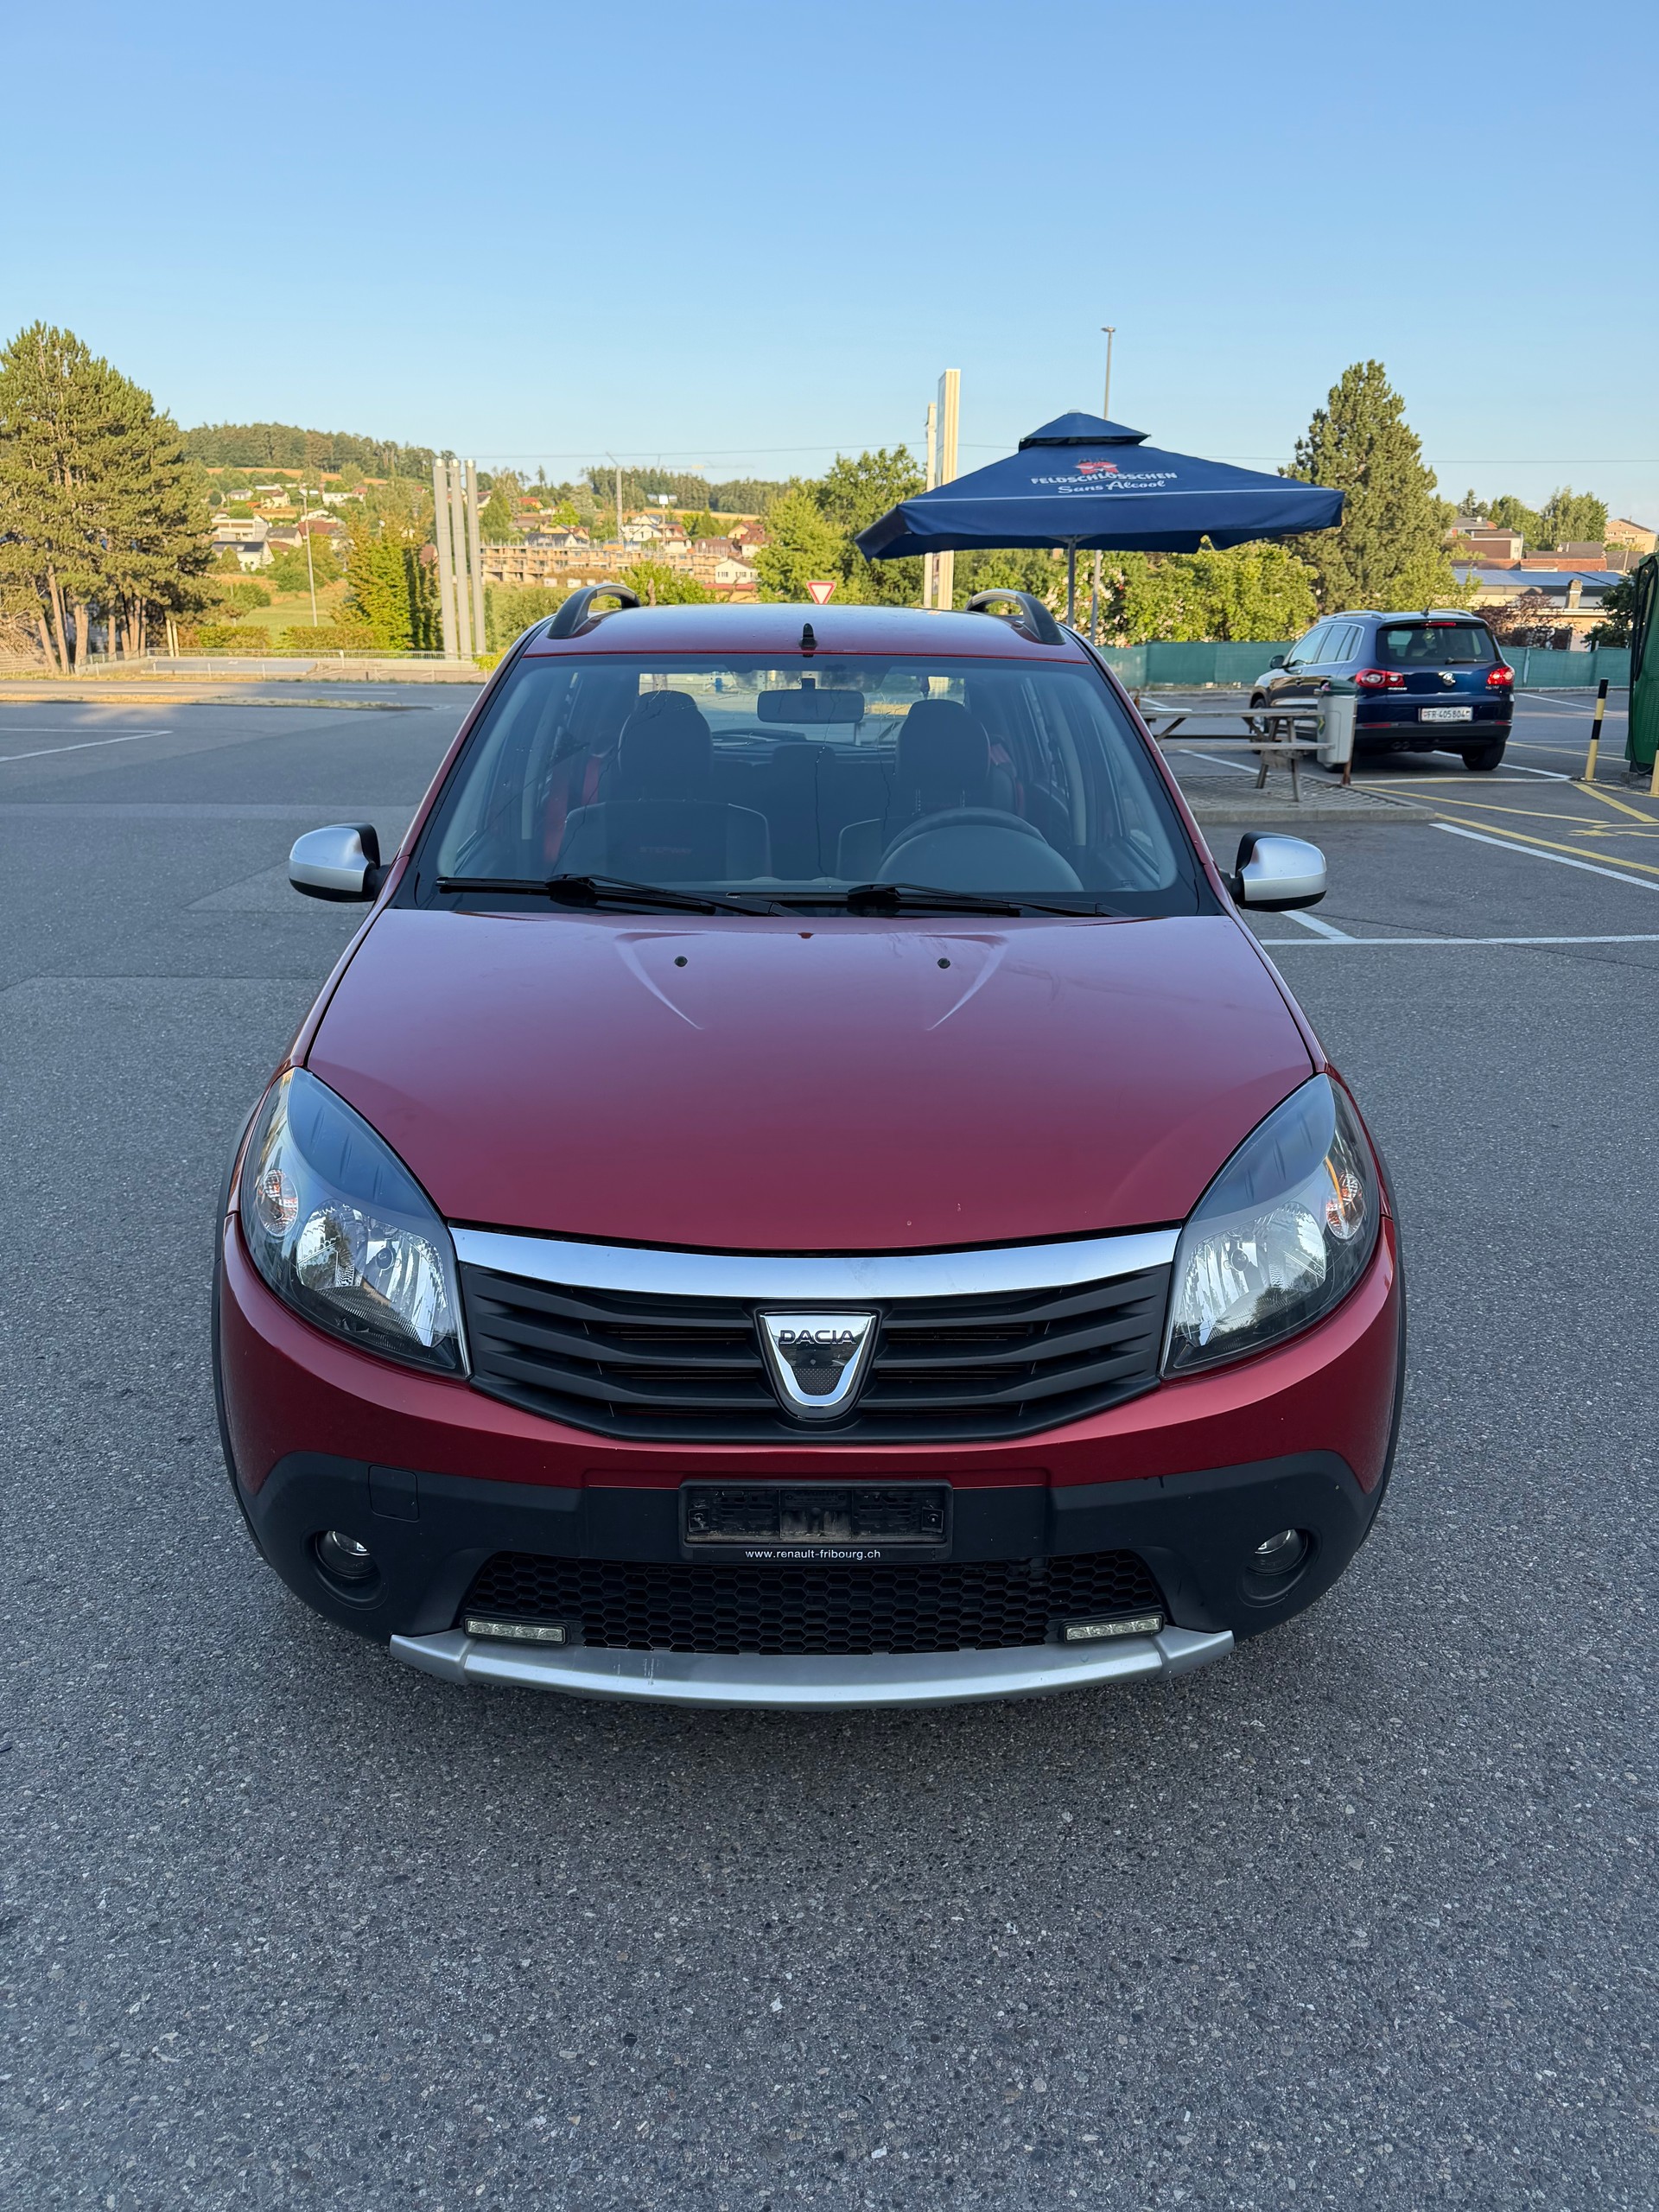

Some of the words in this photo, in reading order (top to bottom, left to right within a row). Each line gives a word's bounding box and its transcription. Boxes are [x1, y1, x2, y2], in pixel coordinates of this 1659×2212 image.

[1030, 471, 1178, 485] FELDSCHLÖSSCHEN
[1058, 485, 1103, 493] Sans
[1105, 480, 1166, 491] Alcool
[779, 1330, 856, 1344] DACIA
[745, 1549, 880, 1560] www.renault-fribourg.ch
